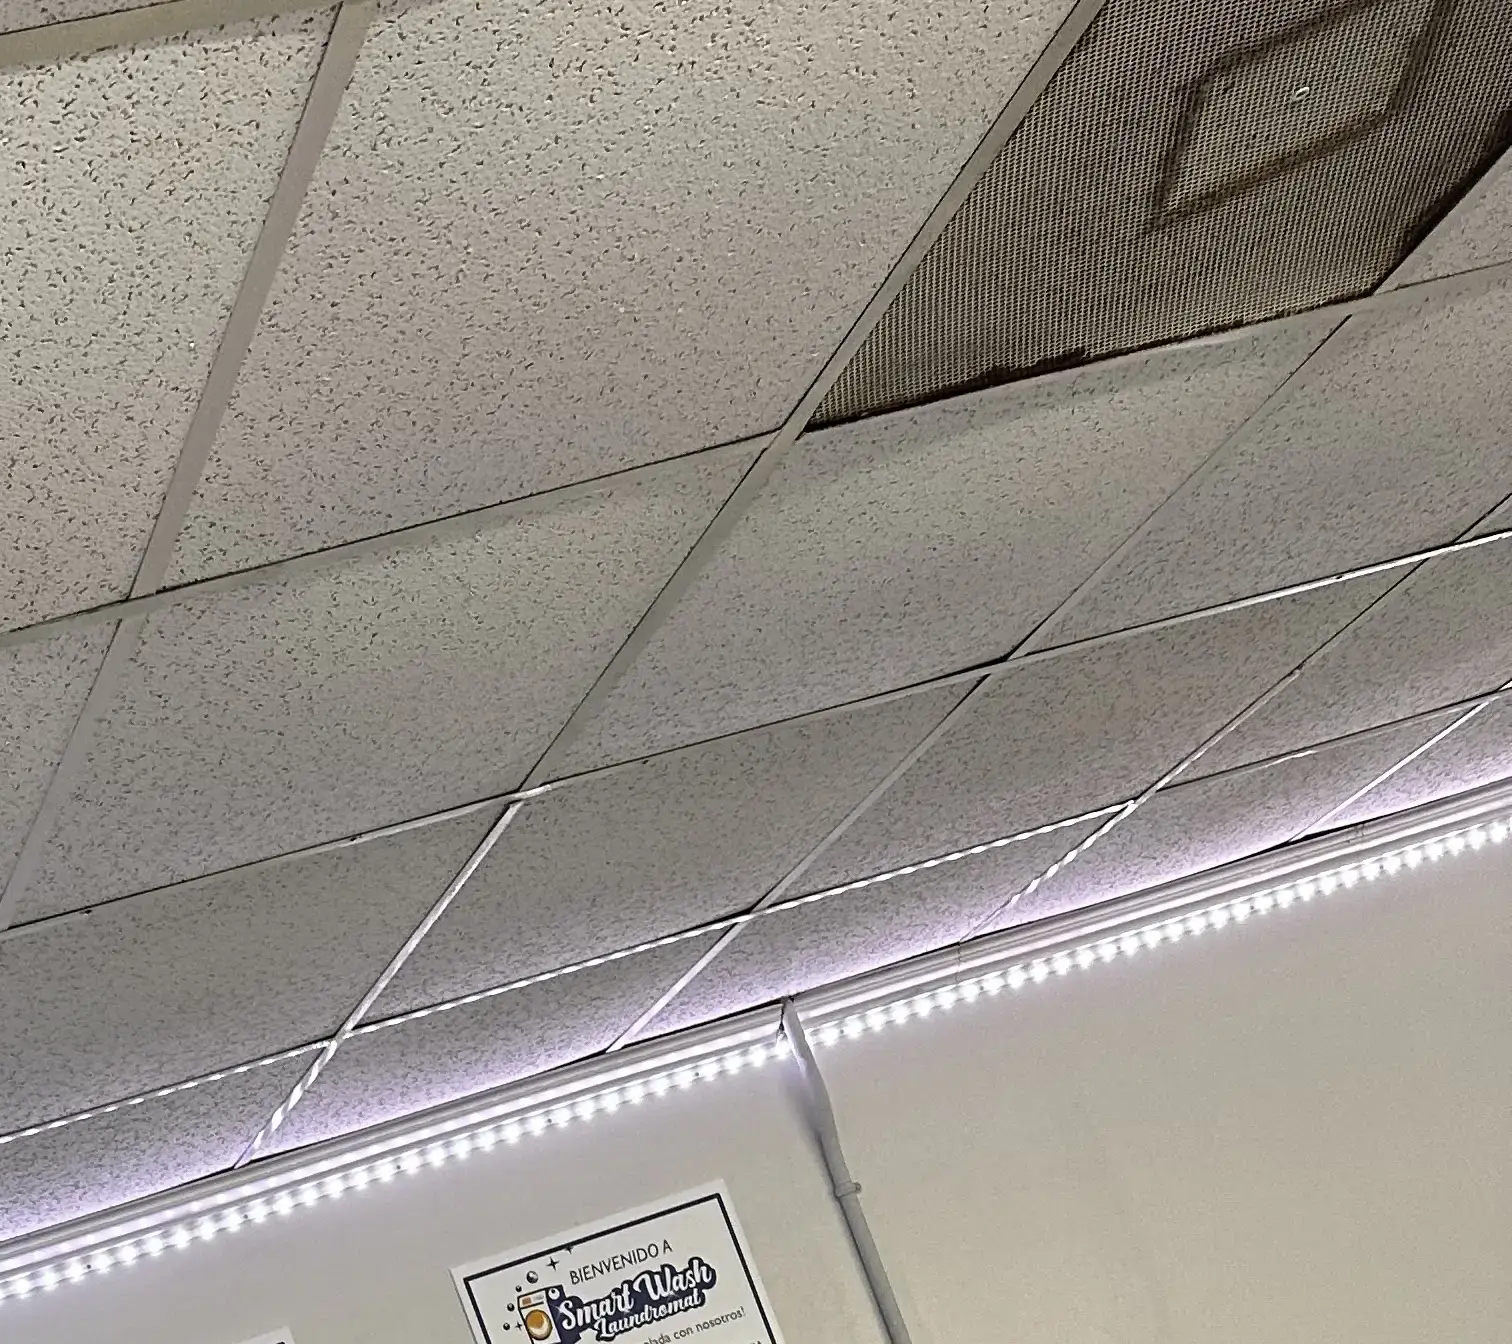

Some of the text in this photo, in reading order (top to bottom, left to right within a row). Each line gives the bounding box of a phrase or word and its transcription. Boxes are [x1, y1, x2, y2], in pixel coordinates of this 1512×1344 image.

[569, 1239, 673, 1285] BIENVENIDO A
[561, 1256, 714, 1329] Smart Wash
[597, 1290, 702, 1337] Laundromat
[673, 1326, 694, 1340] con
[695, 1305, 745, 1333] nosotros!
